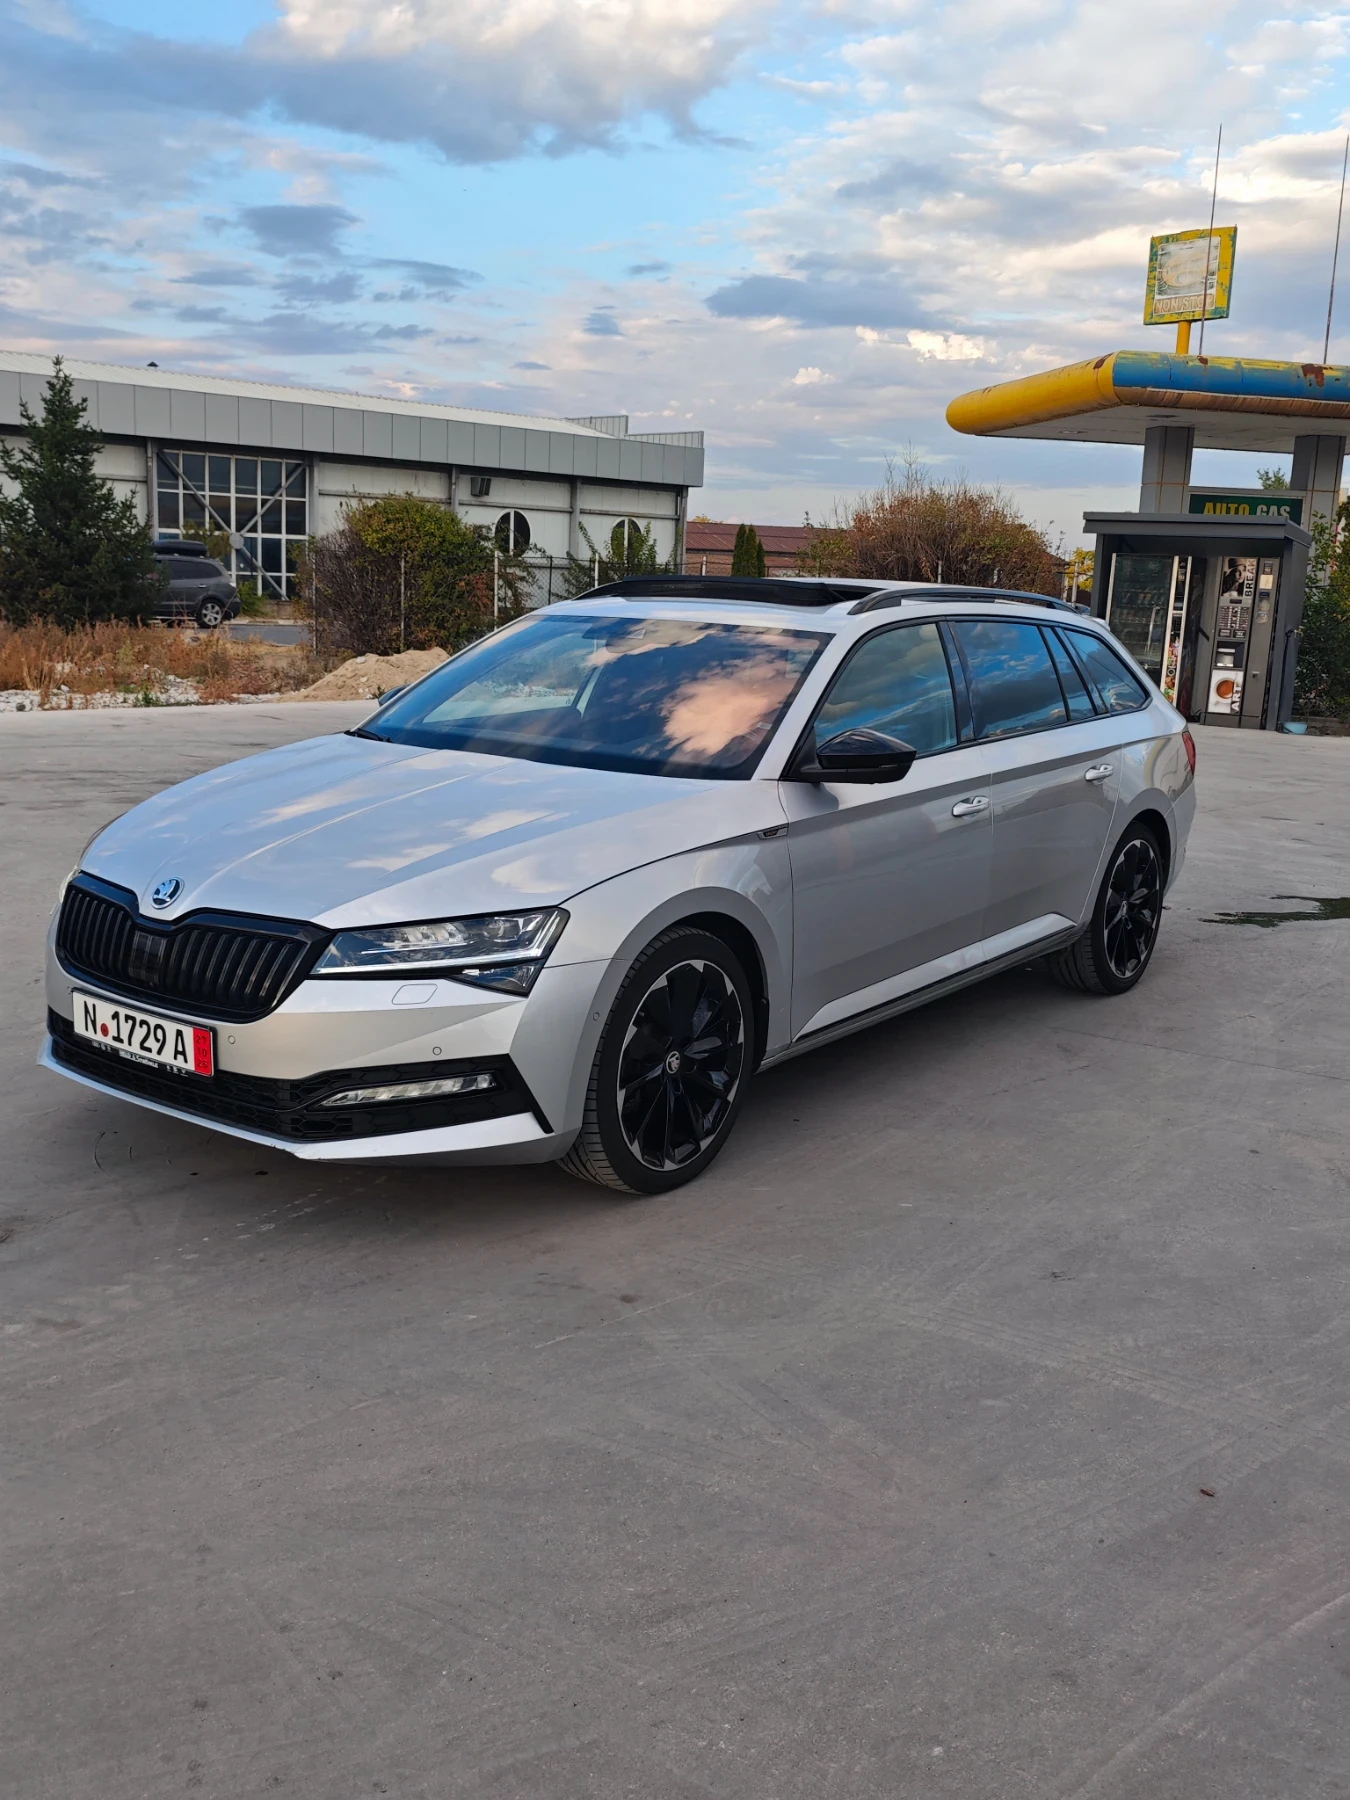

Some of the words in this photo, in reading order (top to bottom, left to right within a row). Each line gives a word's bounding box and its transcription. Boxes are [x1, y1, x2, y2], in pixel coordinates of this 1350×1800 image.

[1203, 502, 1250, 516] AUTO
[1256, 504, 1291, 520] GAS
[1245, 560, 1256, 597] BREAK
[1231, 682, 1242, 712] ART
[83, 1000, 98, 1034] N
[111, 1010, 167, 1056] 1729
[173, 1028, 189, 1064] A
[196, 1034, 207, 1045] 27
[197, 1046, 208, 1058] 10
